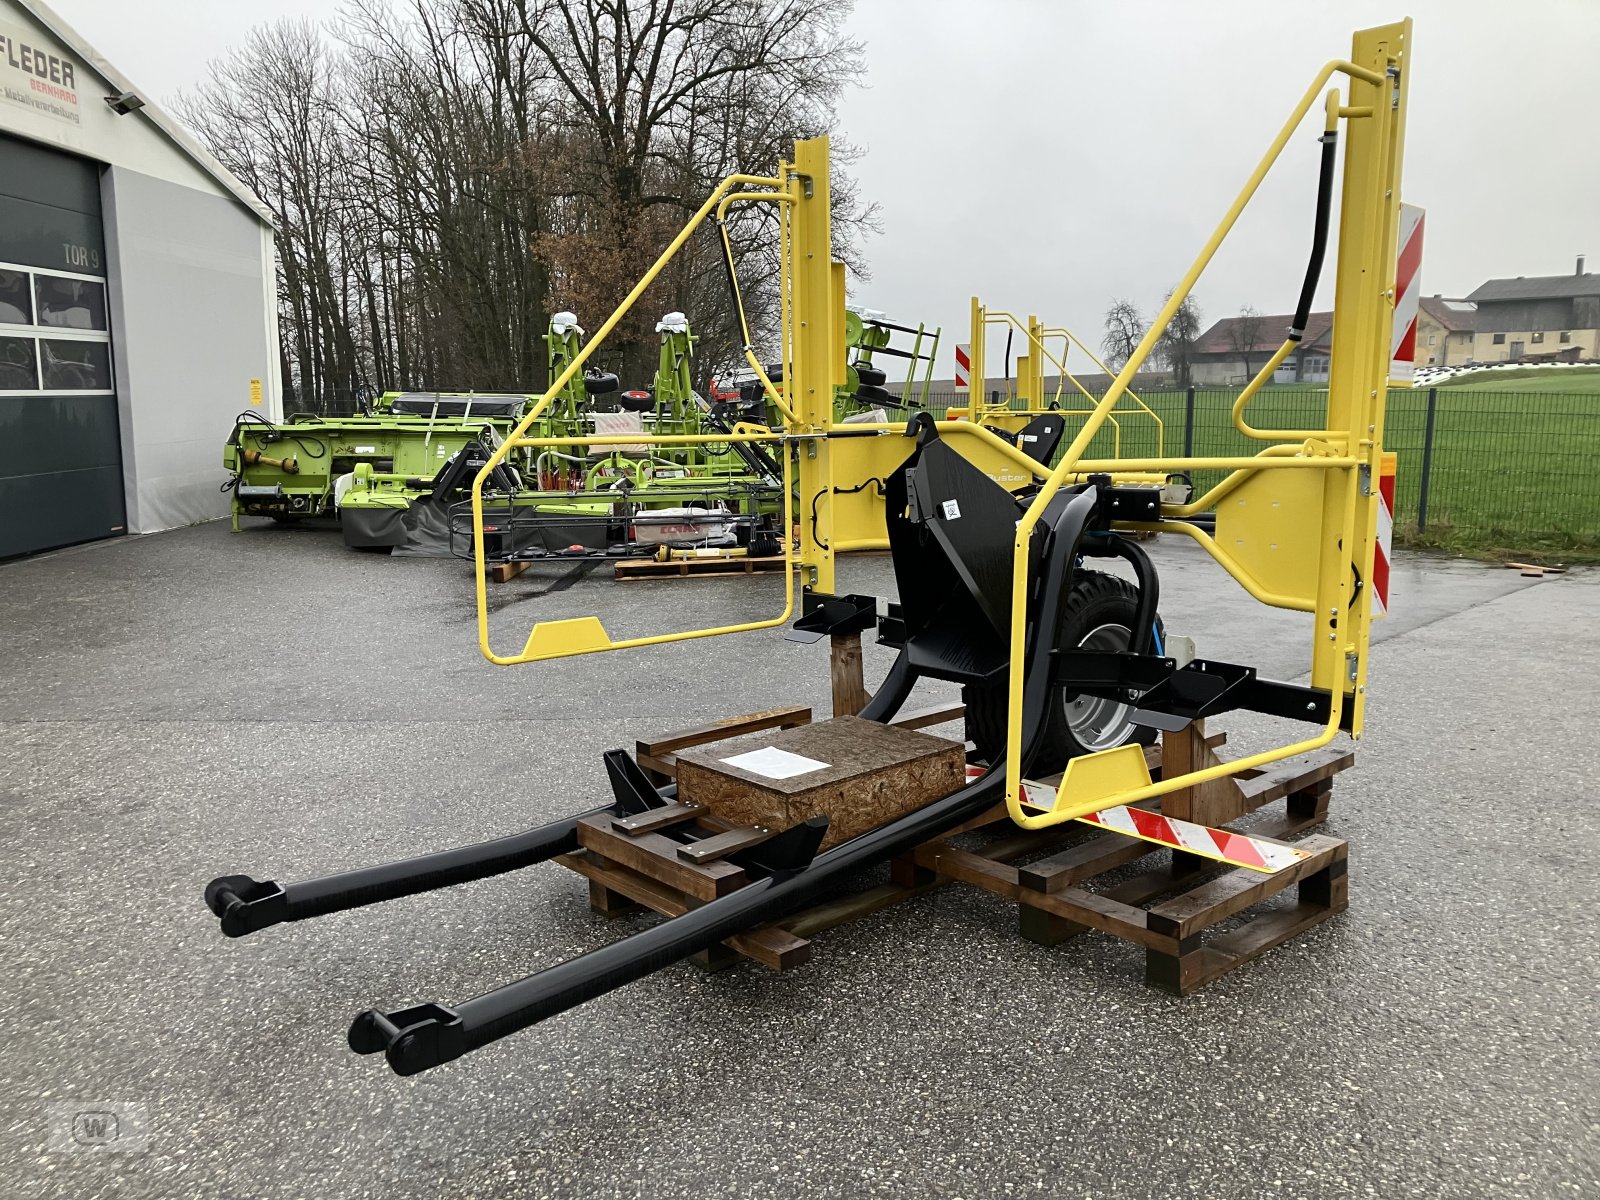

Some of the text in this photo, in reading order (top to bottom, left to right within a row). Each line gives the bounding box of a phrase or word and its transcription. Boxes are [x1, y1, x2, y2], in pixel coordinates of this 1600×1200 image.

[30, 79, 77, 105] BERNHARD
[62, 243, 99, 269] TOR 9
